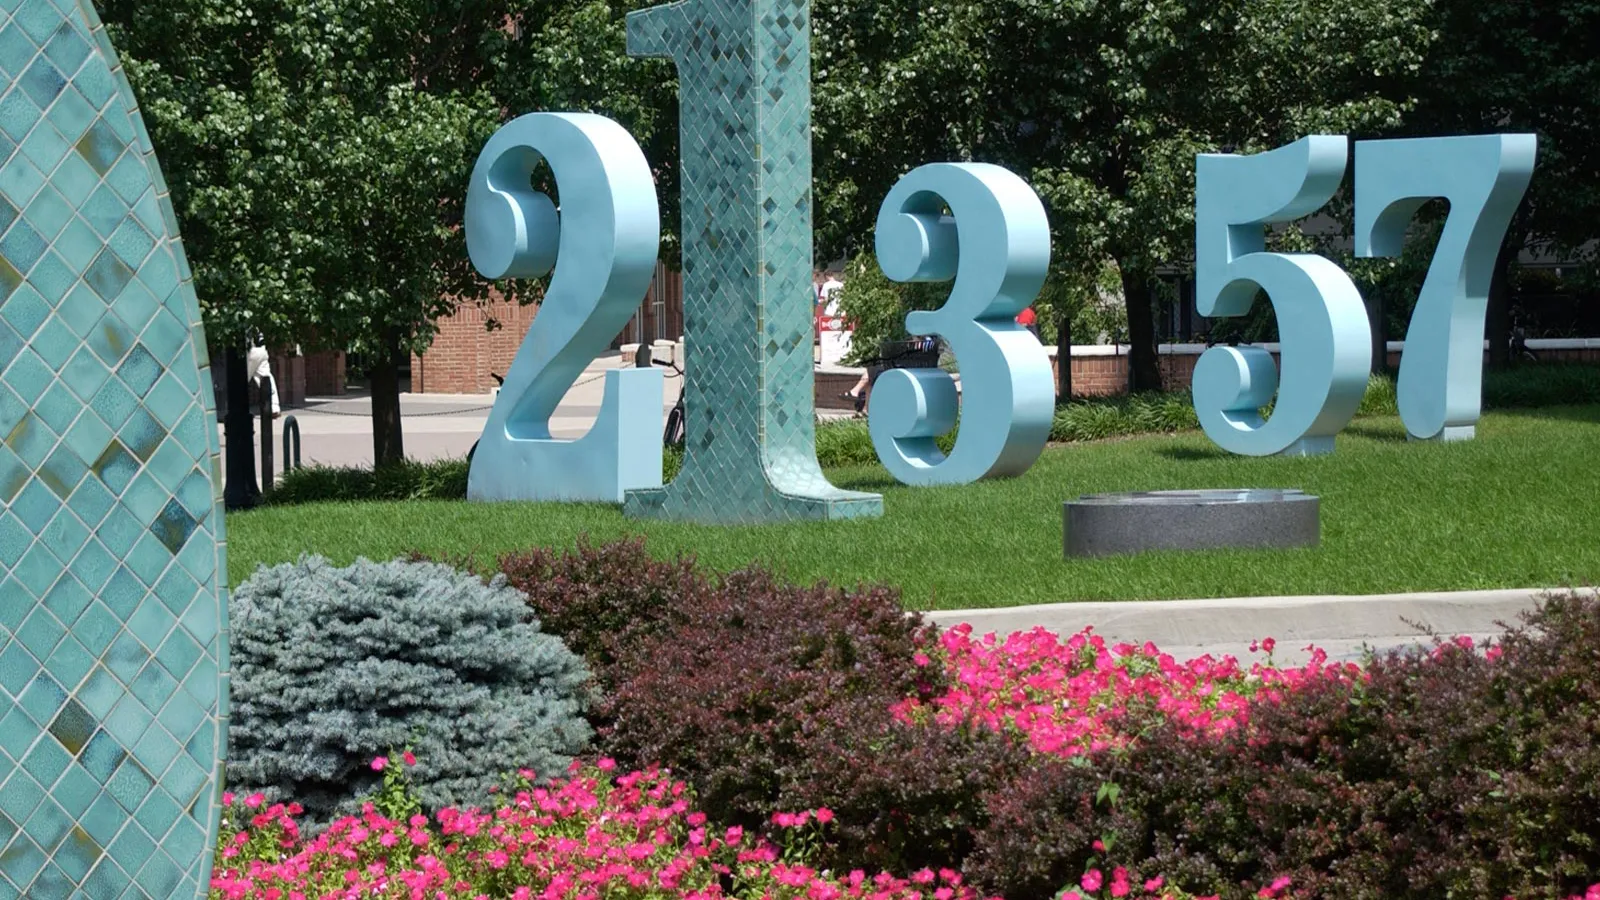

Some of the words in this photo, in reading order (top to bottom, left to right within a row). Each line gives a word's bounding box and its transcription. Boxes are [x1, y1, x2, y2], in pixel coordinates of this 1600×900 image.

[465, 112, 660, 502] 2
[624, 0, 884, 524] 1
[869, 162, 1055, 485] 3
[1193, 134, 1372, 457] 5
[1355, 133, 1537, 441] 7
